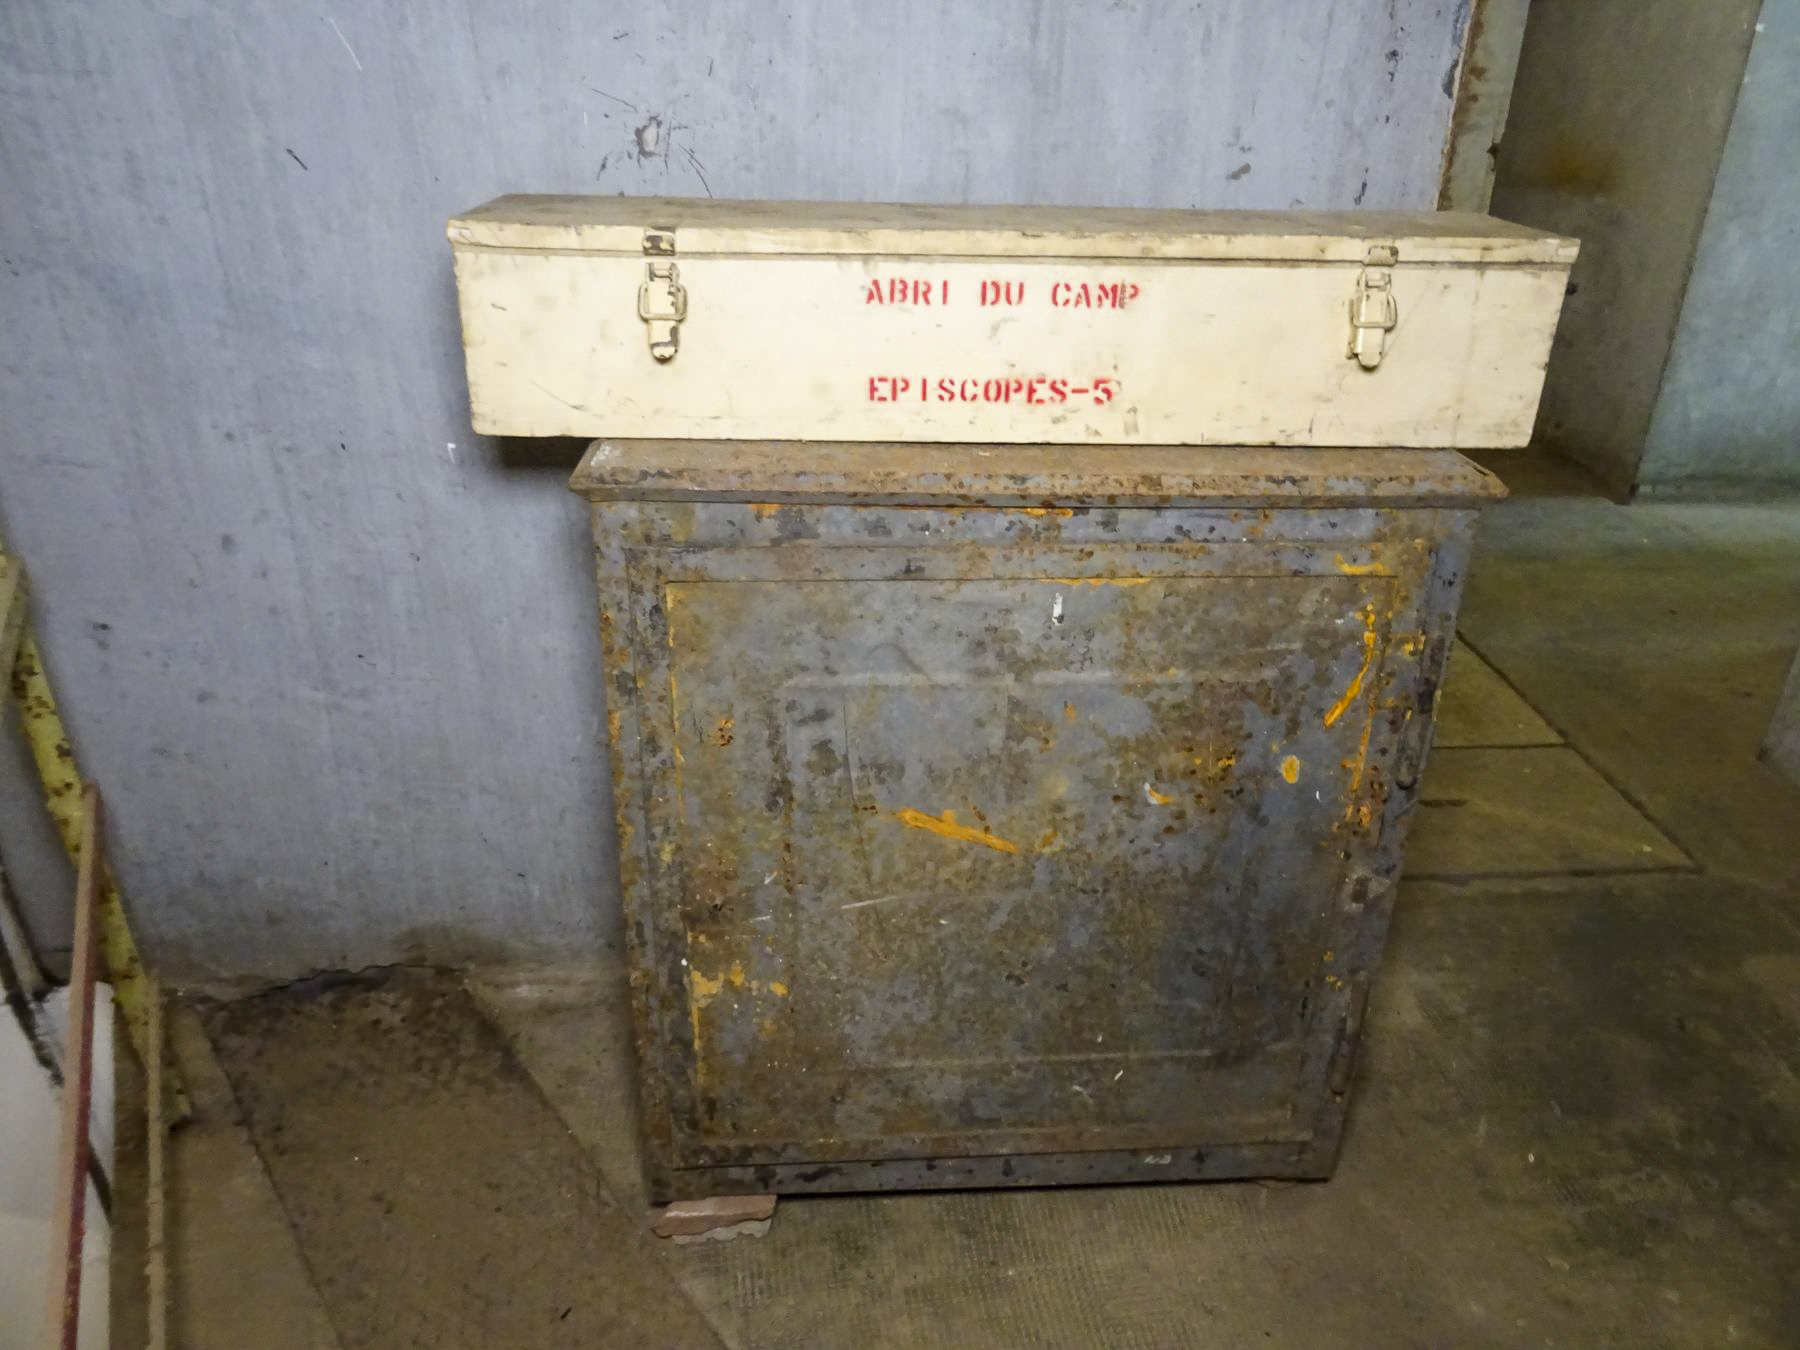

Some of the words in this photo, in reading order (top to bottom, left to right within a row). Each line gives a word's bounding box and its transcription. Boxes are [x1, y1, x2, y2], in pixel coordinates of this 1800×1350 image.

[865, 278, 949, 305] ABRI
[980, 280, 1025, 306] DU
[1051, 281, 1140, 309] CAMP
[868, 376, 1114, 406] EPISCOPES-5
